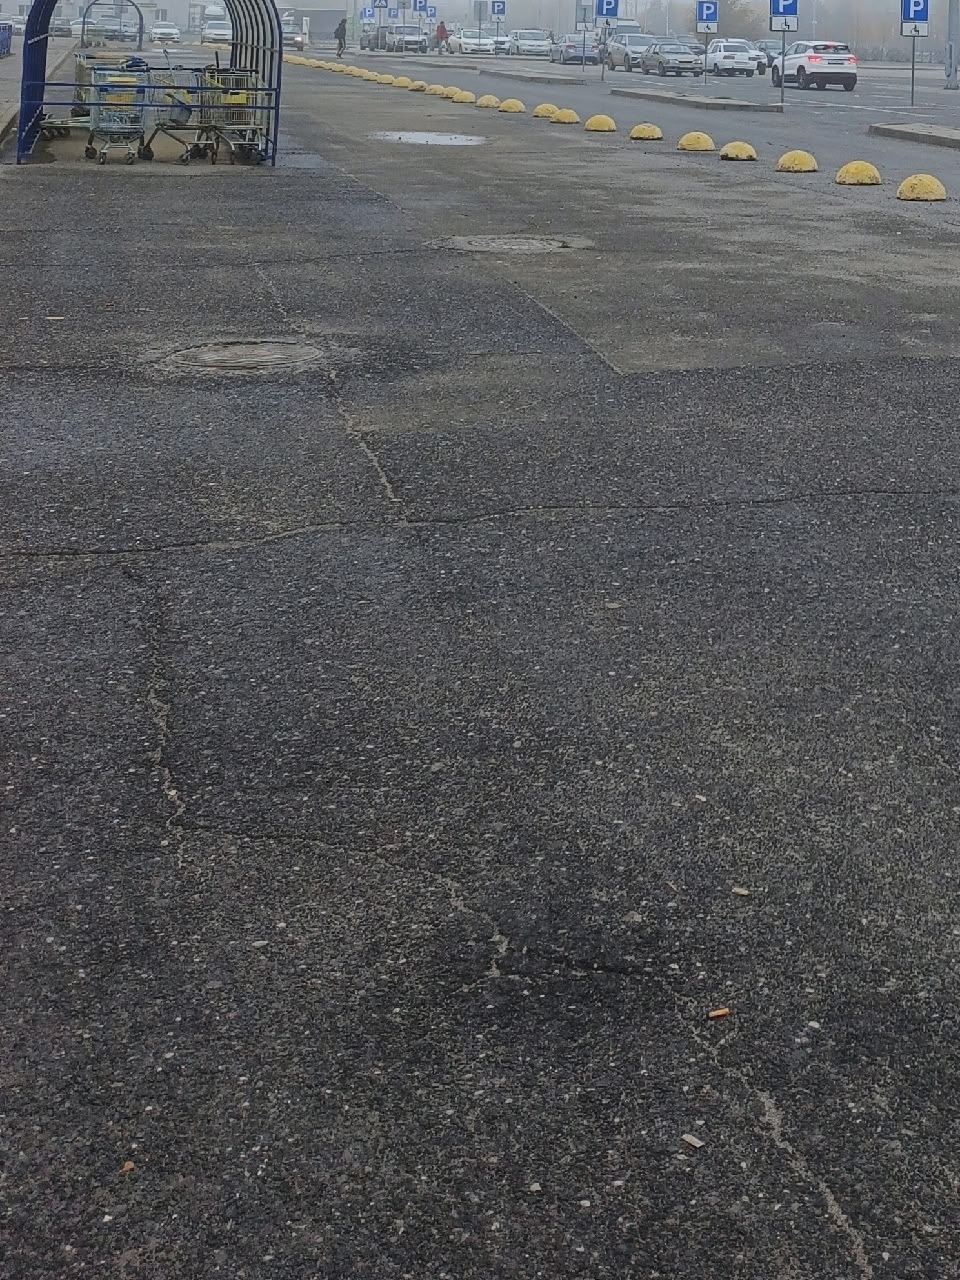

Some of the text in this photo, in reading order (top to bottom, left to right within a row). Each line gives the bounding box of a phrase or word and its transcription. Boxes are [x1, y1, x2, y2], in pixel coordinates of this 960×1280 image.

[365, 8, 373, 17] P
[427, 7, 435, 17] P
[494, 2, 503, 14] P
[702, 2, 715, 20] P
